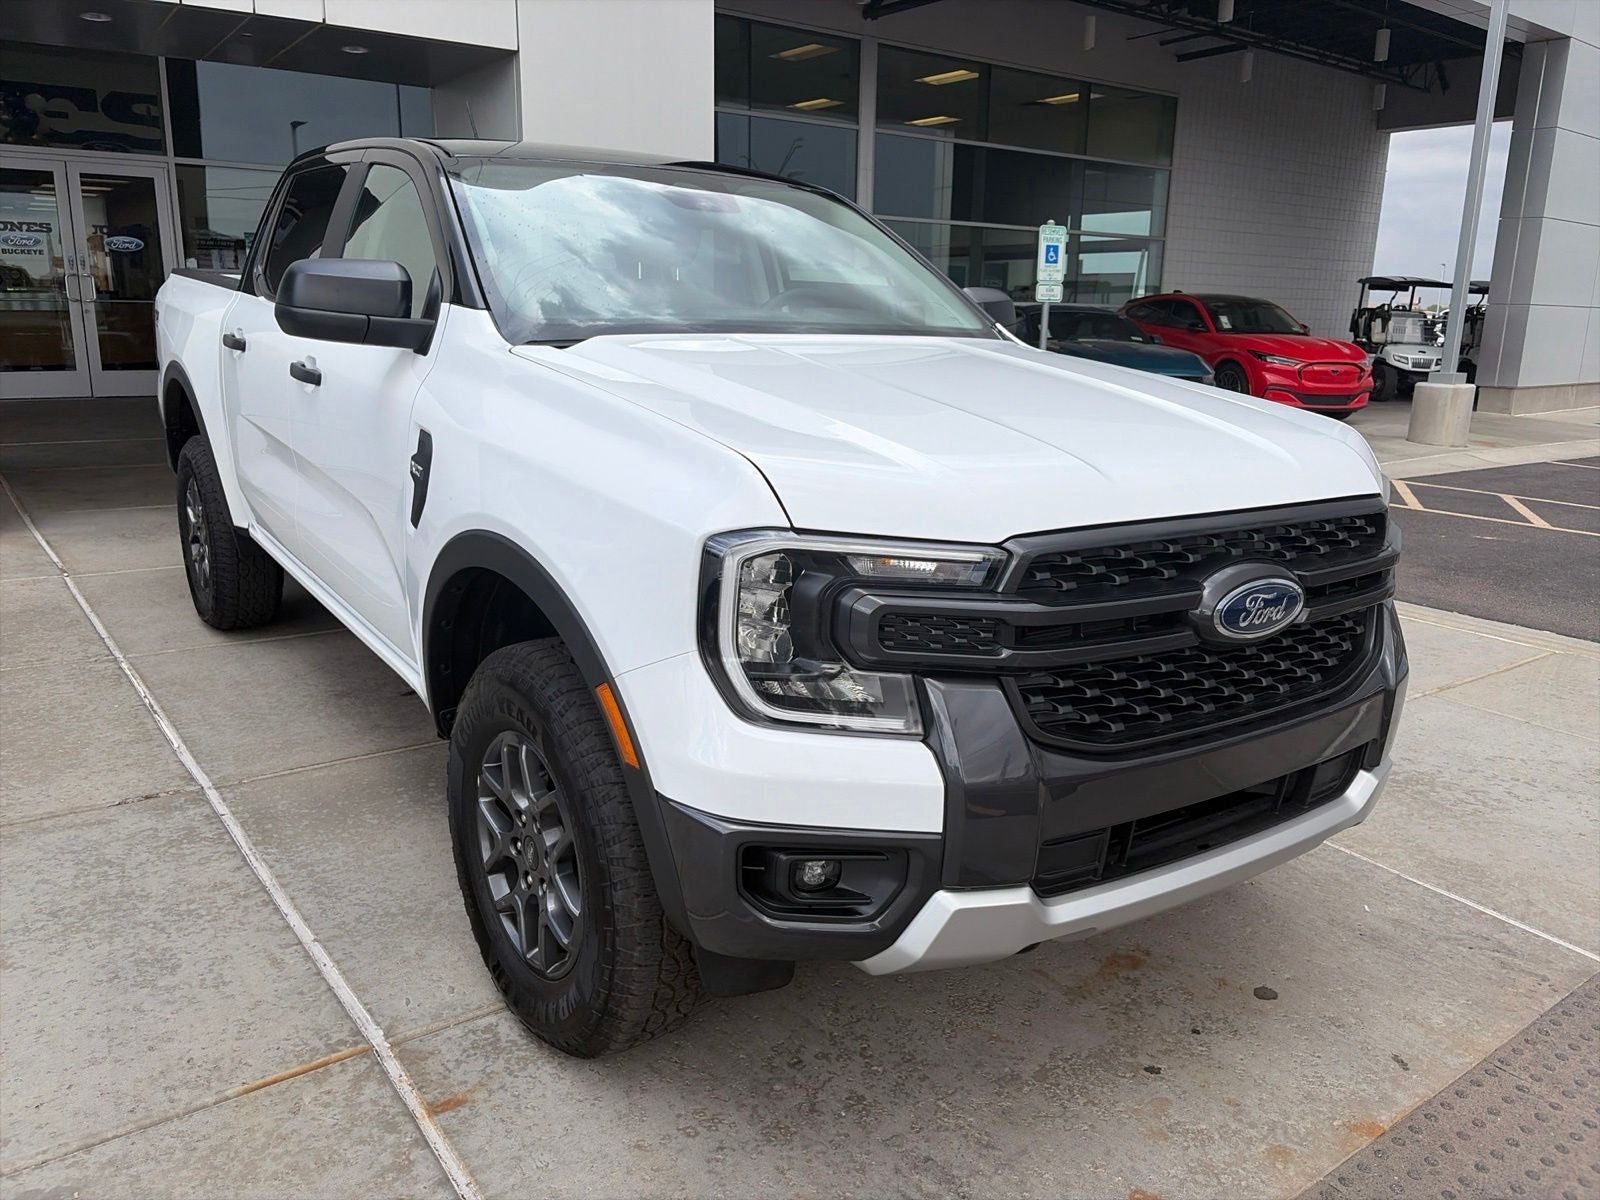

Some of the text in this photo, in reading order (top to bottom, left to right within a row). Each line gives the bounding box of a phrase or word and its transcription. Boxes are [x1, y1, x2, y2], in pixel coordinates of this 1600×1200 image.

[8, 234, 35, 245] Ford
[111, 239, 137, 249] Ford
[1238, 592, 1292, 627] Ford
